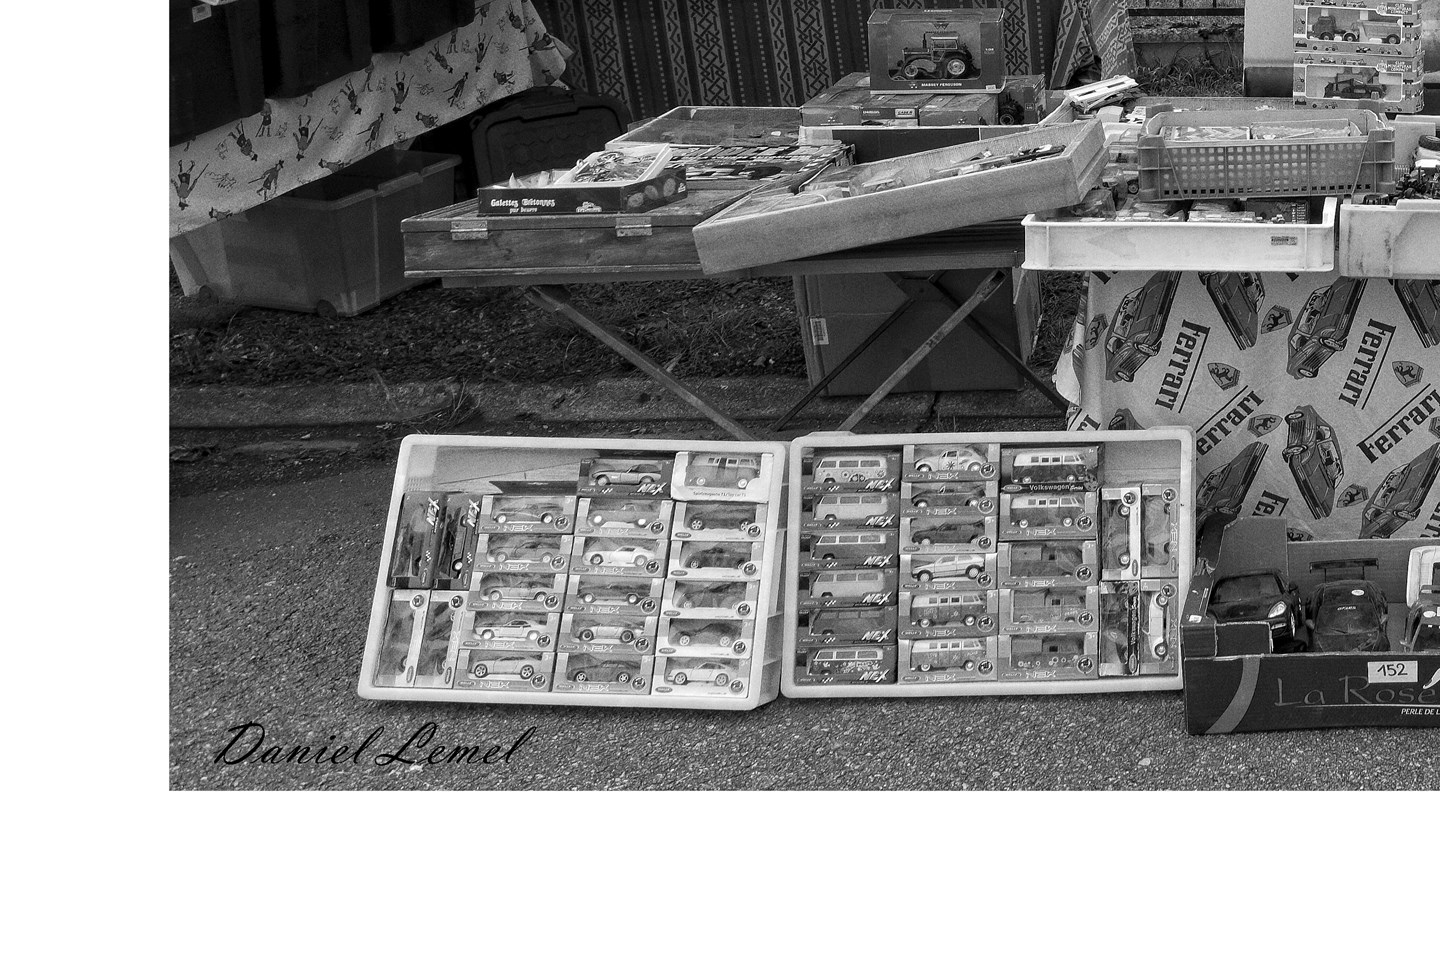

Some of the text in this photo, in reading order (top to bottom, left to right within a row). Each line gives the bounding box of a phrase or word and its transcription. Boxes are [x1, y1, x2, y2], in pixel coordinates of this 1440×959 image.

[490, 198, 519, 207] Galettes
[1155, 319, 1211, 412] Ferrari
[1339, 318, 1396, 409] Ferrari
[1195, 390, 1265, 459] errari
[865, 478, 895, 492] NEX
[865, 514, 895, 528] NEX
[863, 554, 892, 567] NEX
[862, 591, 892, 605] NEX
[861, 628, 891, 642] NEX
[859, 668, 889, 682] NEX
[1376, 663, 1408, 677] 152
[1274, 678, 1326, 707] La
[1400, 707, 1423, 716] PERLE
[1424, 707, 1434, 716] DE
